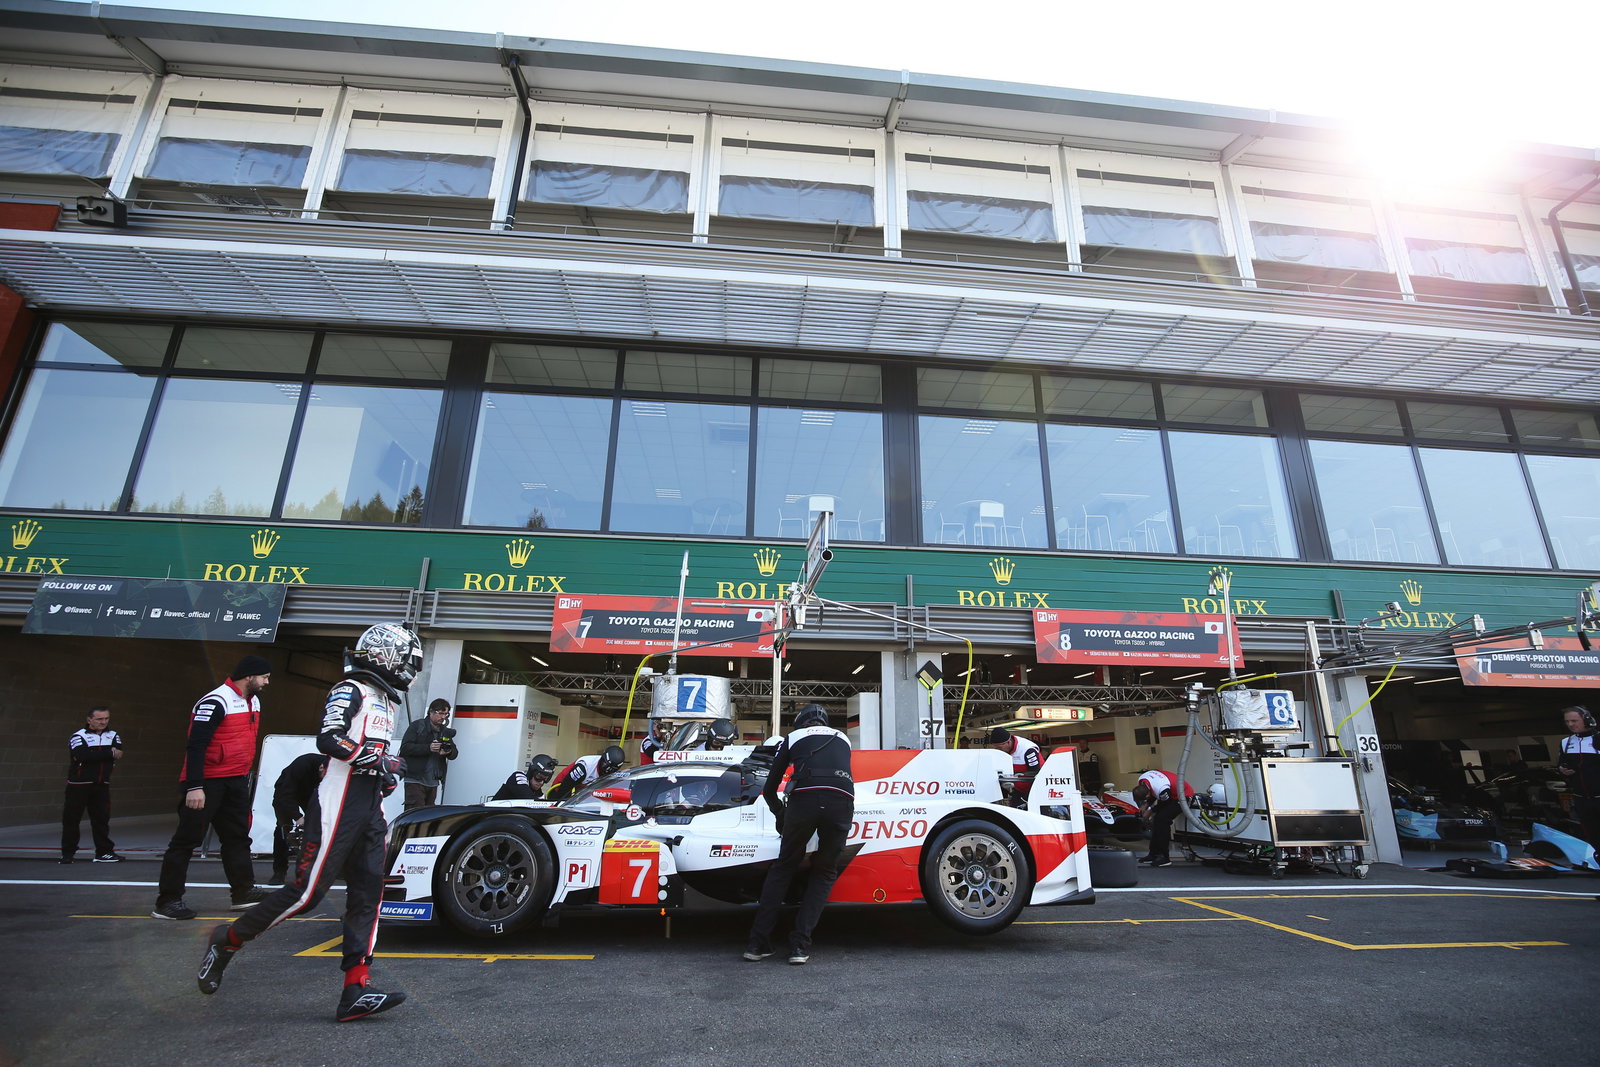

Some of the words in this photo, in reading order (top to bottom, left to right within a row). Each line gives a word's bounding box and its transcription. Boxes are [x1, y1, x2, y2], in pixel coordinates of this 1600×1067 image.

[0, 556, 69, 575] LEX
[203, 563, 309, 584] ROLEX
[42, 581, 82, 590] FOLLOW
[83, 583, 97, 591] US
[463, 572, 566, 593] ROLEX
[716, 581, 798, 600] ROLE
[560, 599, 570, 608] P1
[571, 599, 582, 608] HY
[957, 590, 1050, 608] ROLEX
[64, 606, 93, 614] @fiawec
[115, 607, 137, 616] fiawec
[1181, 597, 1268, 615] ROLEX
[164, 610, 210, 619] fiawec_official
[236, 612, 261, 620] FIAWEC
[1048, 613, 1058, 621] HY
[1377, 610, 1457, 628] ROLEX
[608, 616, 650, 626] TOYOTA
[693, 619, 735, 629] RACING
[580, 621, 592, 638] 7
[1083, 629, 1122, 638] TOYOTA
[1124, 631, 1157, 639] GAZOO
[1159, 631, 1195, 640] RACING
[1060, 633, 1072, 650] 8
[1491, 653, 1567, 663] DEMPSEY-PROTON
[1568, 655, 1599, 664] RACING
[1474, 658, 1492, 673] 77
[683, 680, 702, 710] 7
[1072, 710, 1077, 718] 8
[1272, 695, 1290, 722] 8
[921, 719, 943, 736] 37
[1359, 735, 1378, 752] 36
[657, 751, 690, 761] ZENT
[875, 781, 940, 795] DENSO
[1045, 777, 1072, 786] JTEKT
[558, 825, 604, 836] RAYS
[846, 819, 928, 840] DENSO
[406, 845, 435, 853] AISIN
[612, 839, 654, 849] DHL
[710, 848, 731, 857] GR
[567, 863, 588, 883] P1
[628, 859, 653, 898] 7
[381, 906, 426, 915] MICHELIN
